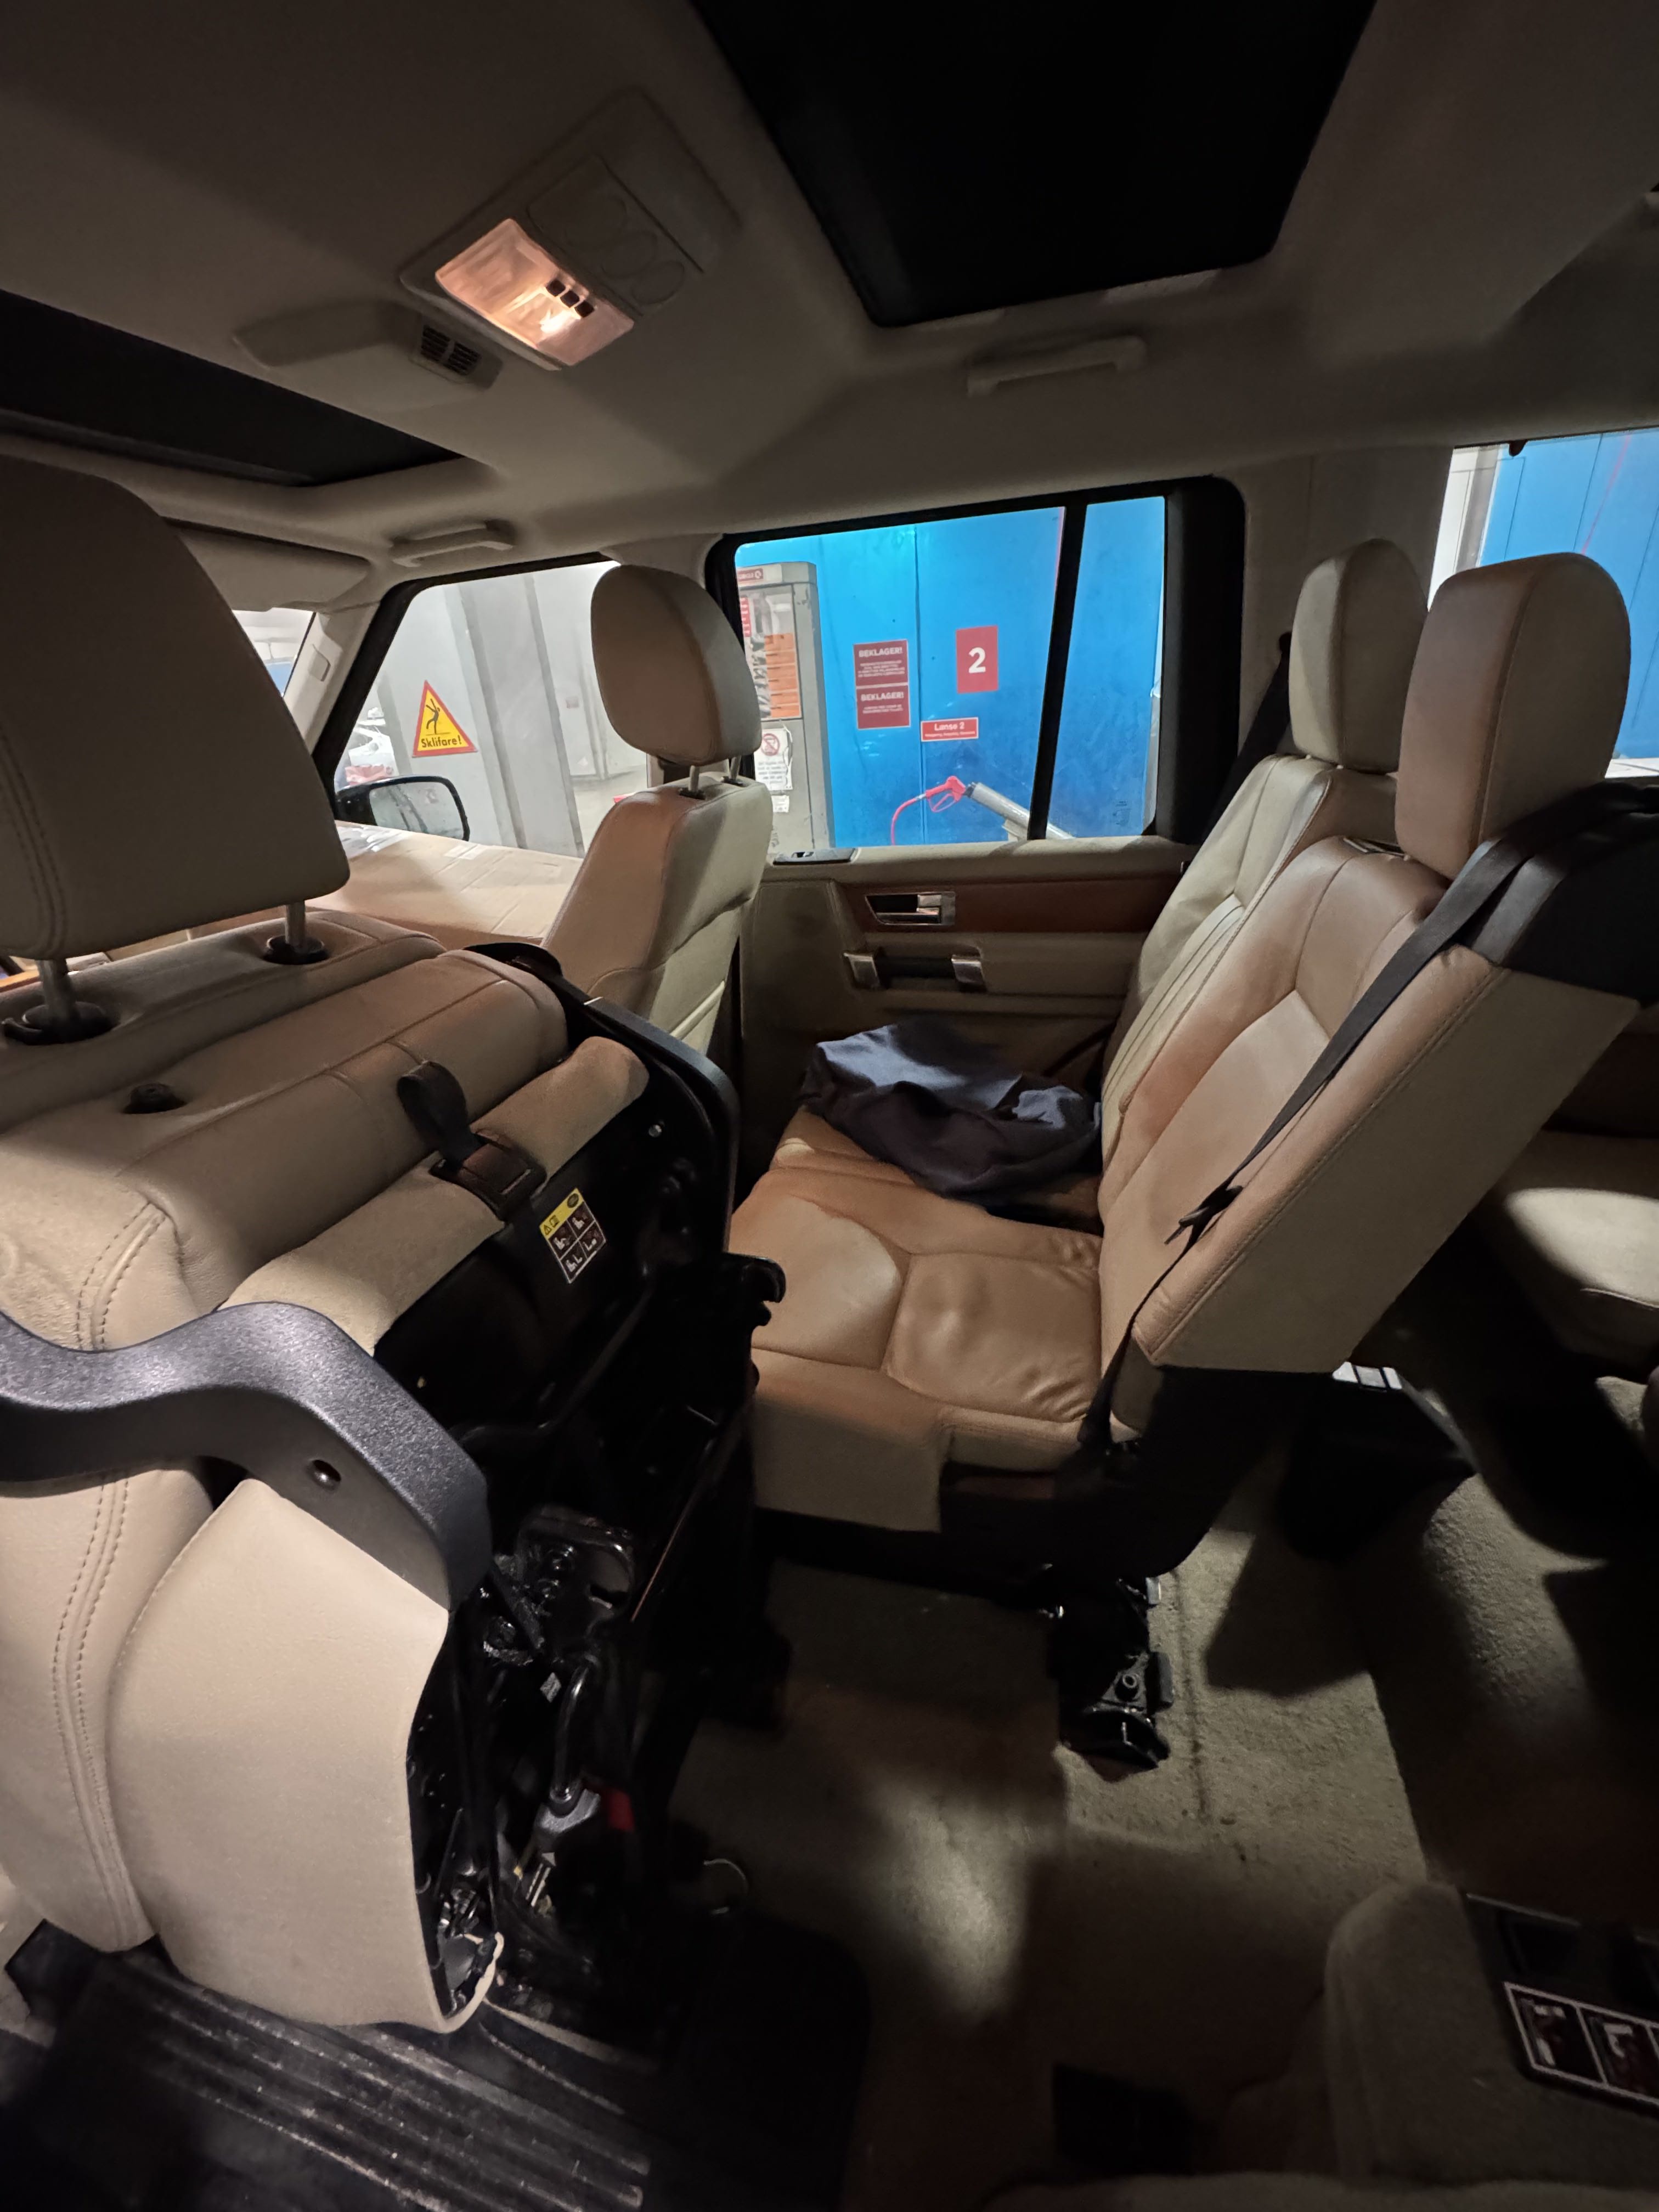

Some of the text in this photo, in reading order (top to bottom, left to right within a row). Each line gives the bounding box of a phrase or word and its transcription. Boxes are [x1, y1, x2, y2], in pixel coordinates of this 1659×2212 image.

[859, 647, 902, 657] BEKLAGER!
[968, 647, 986, 674] 2
[861, 692, 904, 702] BEKLAGER!
[959, 721, 965, 730] 2
[421, 735, 462, 748] Sklifare!
